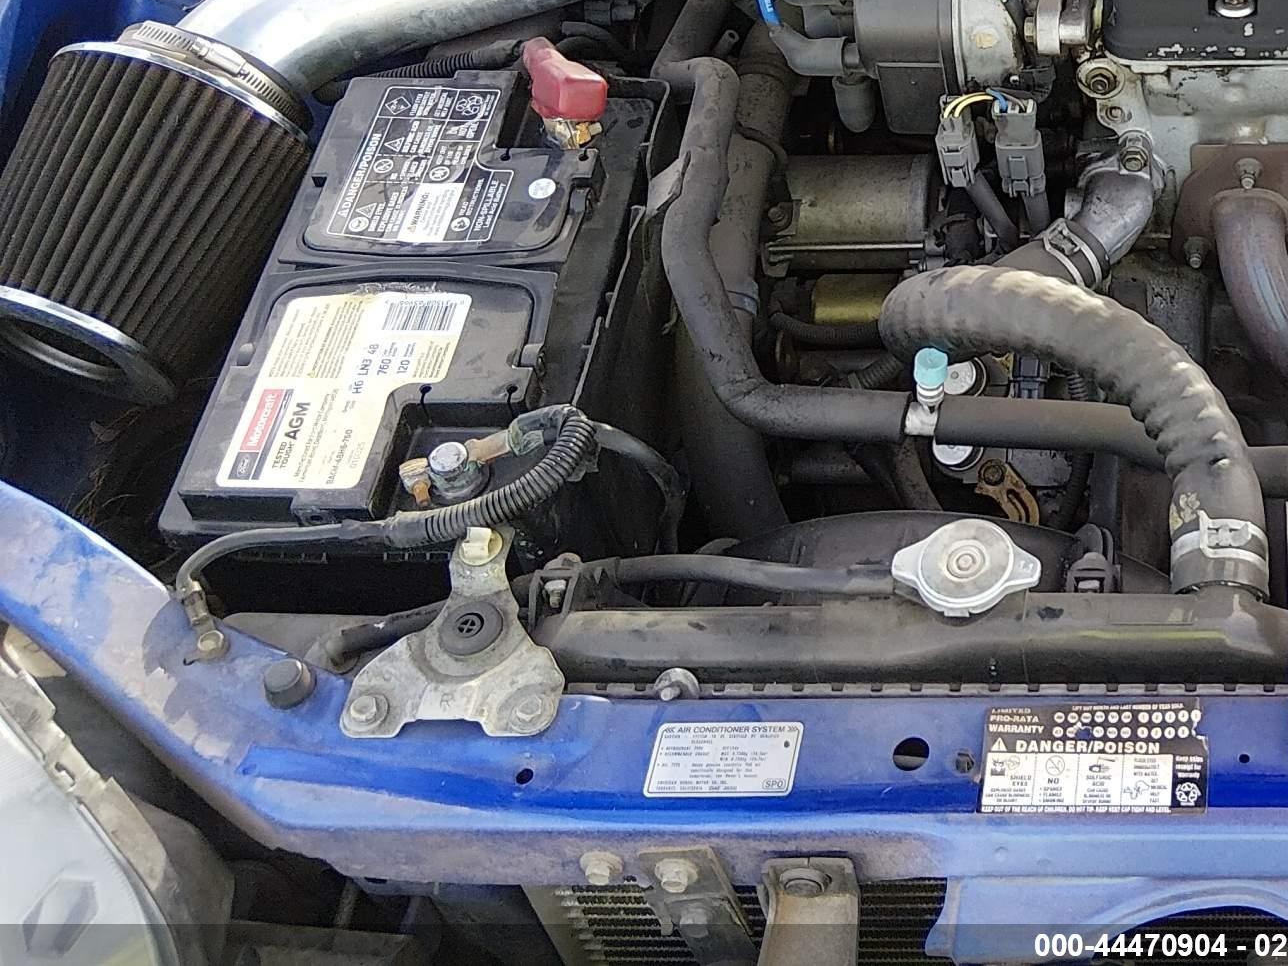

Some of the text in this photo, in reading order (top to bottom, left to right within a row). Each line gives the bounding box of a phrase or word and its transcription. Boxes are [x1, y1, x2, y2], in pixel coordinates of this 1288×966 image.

[340, 132, 382, 208] DANGER/POISON
[472, 179, 500, 231] NON-SPILLABLE
[488, 202, 499, 214] Acid
[483, 214, 494, 227] Lead
[350, 343, 379, 393] H6 LN3 48
[375, 358, 392, 375] 760
[396, 359, 411, 373] 120
[245, 393, 278, 446] Motorcraft
[282, 401, 311, 439] AGM
[271, 441, 288, 468] TESTED
[990, 715, 1040, 723] PRO-RATA
[989, 724, 1045, 734] WARRANTY
[1015, 739, 1160, 754] DANGER/POISON
